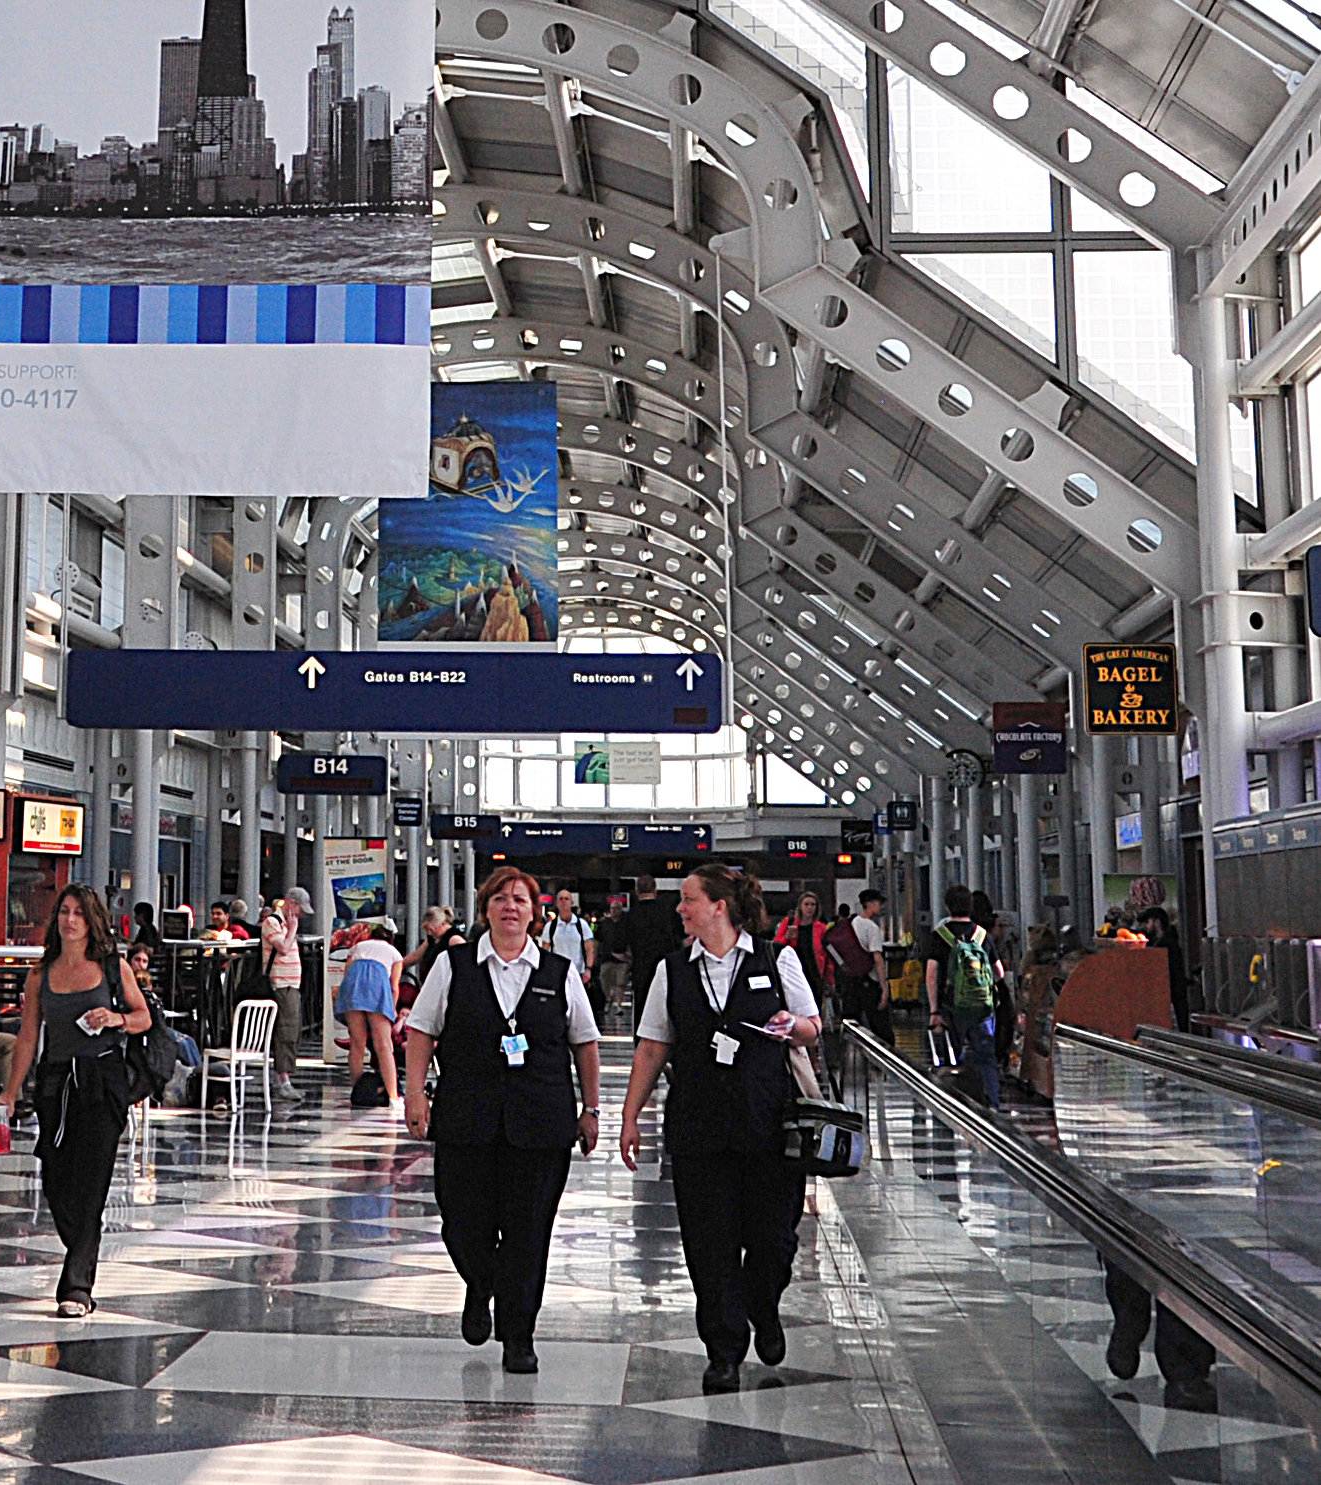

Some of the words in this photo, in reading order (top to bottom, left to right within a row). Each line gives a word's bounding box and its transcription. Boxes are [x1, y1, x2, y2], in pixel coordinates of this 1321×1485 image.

[1090, 652, 1106, 664] THE
[1106, 649, 1130, 660] GREAT
[1131, 649, 1170, 663] AMERICAN
[364, 670, 404, 682] Gates
[409, 671, 466, 683] B14-B22
[573, 672, 636, 683] Restrooms
[1097, 666, 1163, 682] BAGEL
[1092, 709, 1170, 725] BAKERY
[995, 732, 1032, 744] CHOCOLATE
[1033, 732, 1062, 744] FACTORY
[313, 758, 349, 774] B14
[454, 816, 478, 828] B15
[787, 840, 808, 850] B18
[666, 861, 683, 870] B17
